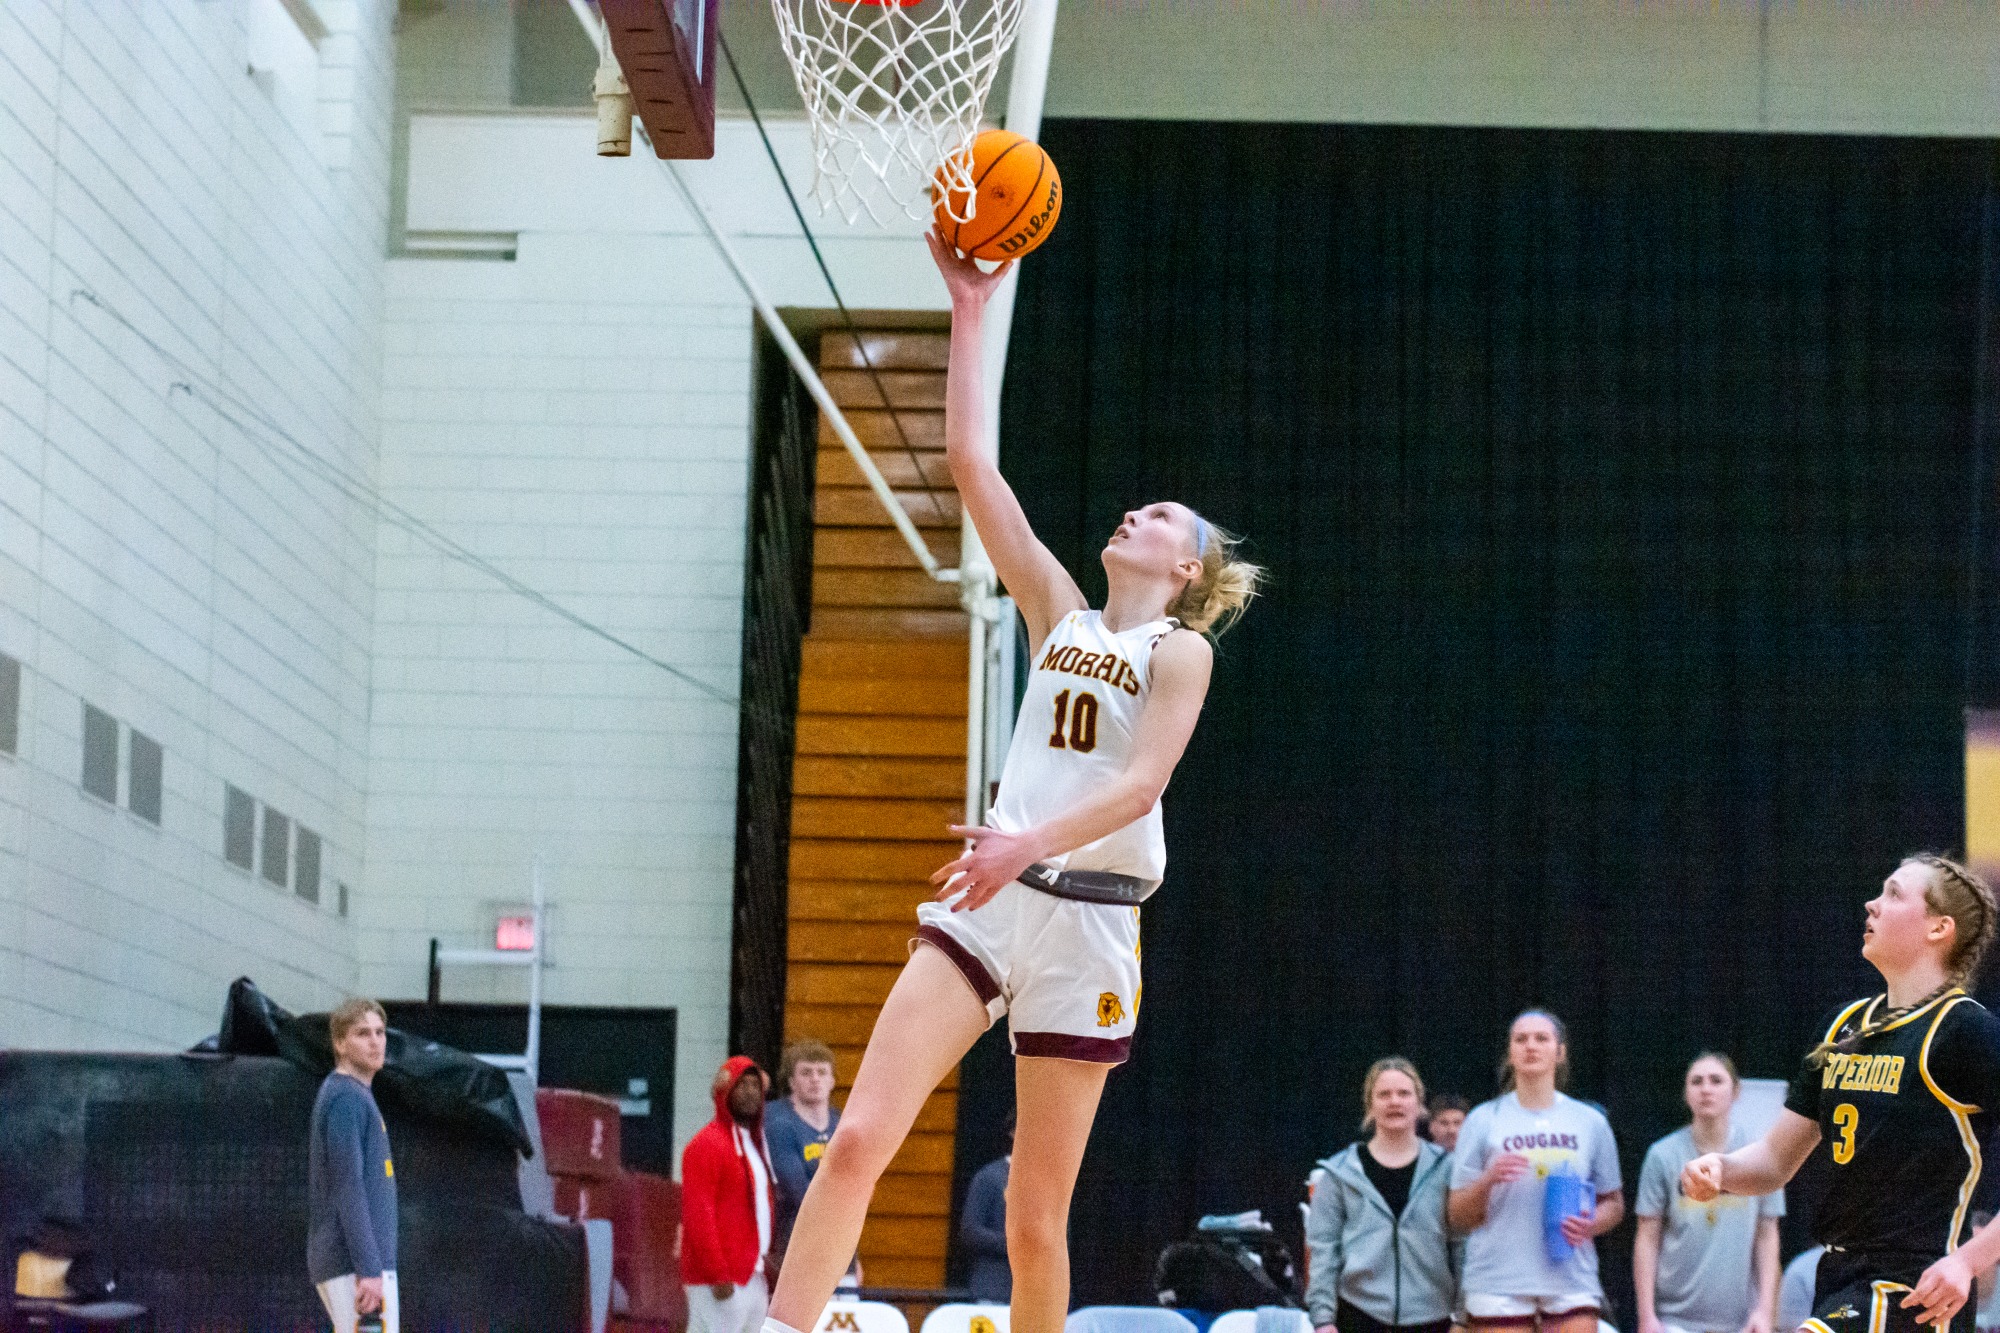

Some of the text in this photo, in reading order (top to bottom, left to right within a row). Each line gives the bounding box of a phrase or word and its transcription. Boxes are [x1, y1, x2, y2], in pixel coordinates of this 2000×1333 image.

[997, 181, 1057, 253] Wilson
[1038, 643, 1140, 697] MORRIS
[1048, 687, 1099, 754] 10
[1503, 1133, 1579, 1152] COUGARS
[1832, 1103, 1859, 1165] 3
